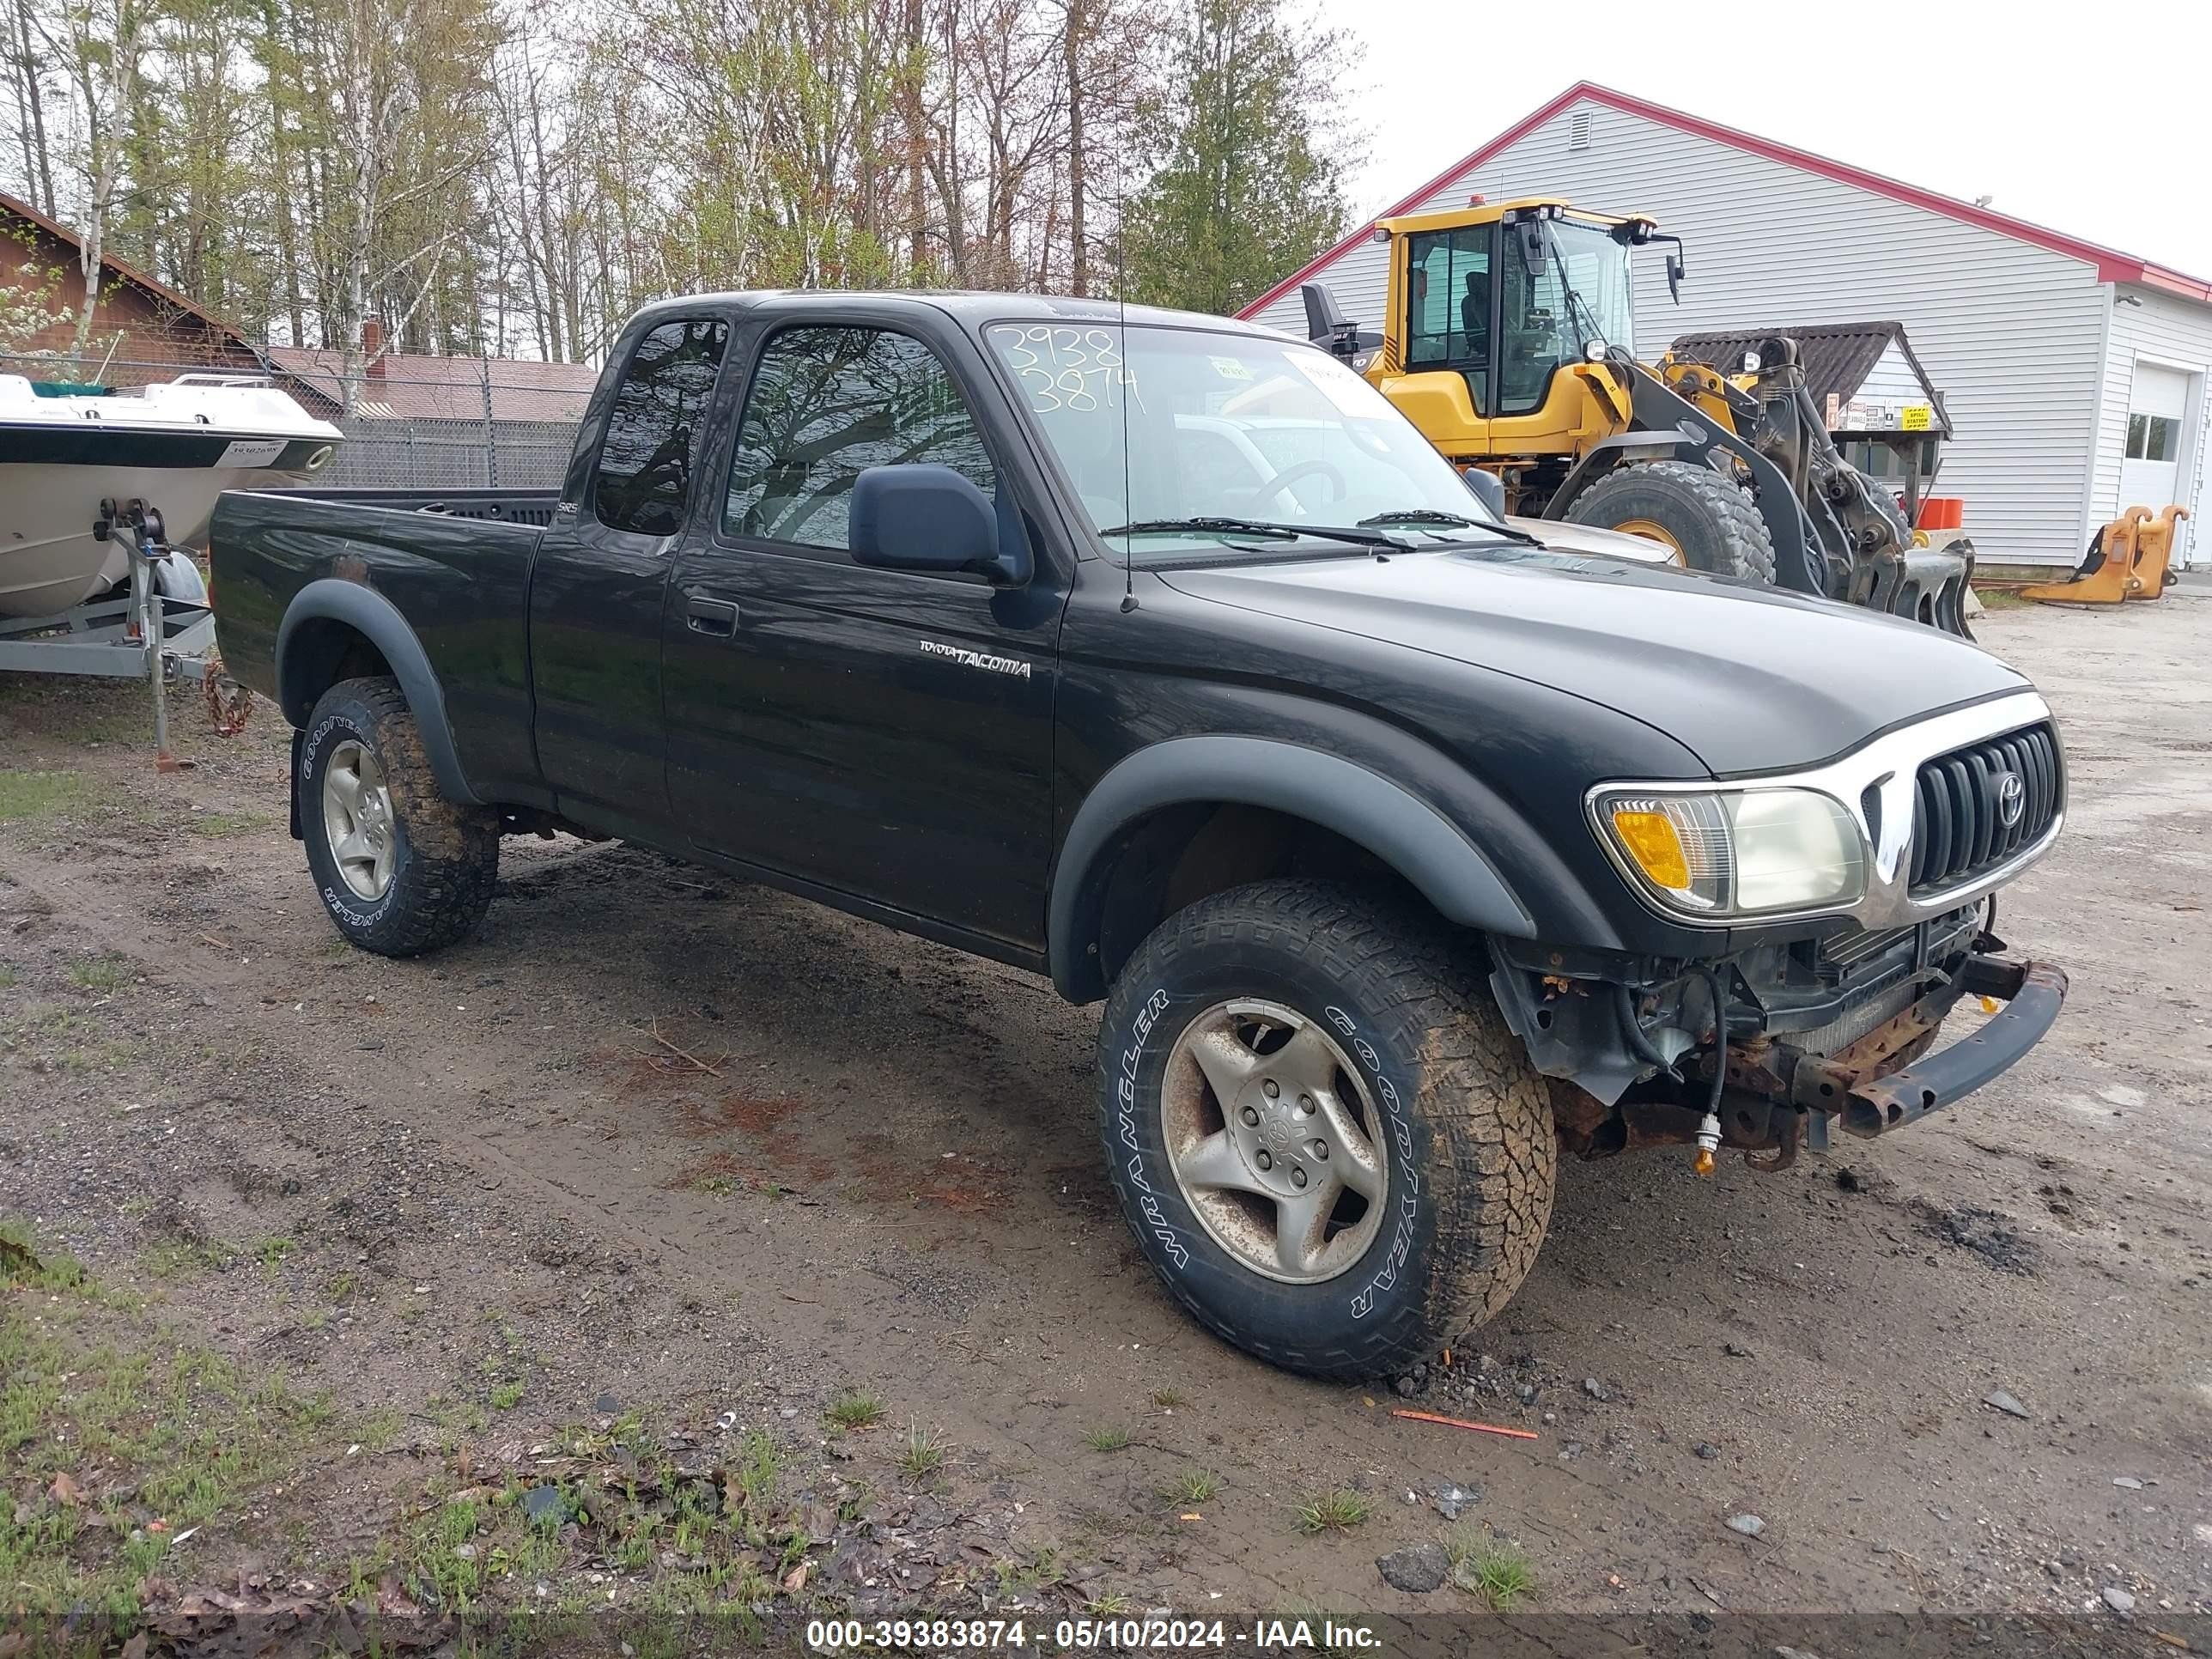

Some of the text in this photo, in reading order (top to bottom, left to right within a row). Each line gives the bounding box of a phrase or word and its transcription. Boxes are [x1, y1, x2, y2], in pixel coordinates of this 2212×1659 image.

[994, 326, 1123, 368] 3938
[1021, 367, 1146, 415] 3874
[920, 641, 1030, 678] TOYOTA TACOMA
[303, 715, 375, 780] GOODYEAR
[1118, 988, 1189, 1270] WRANGLER
[1325, 1006, 1419, 1319] GOODYEAR
